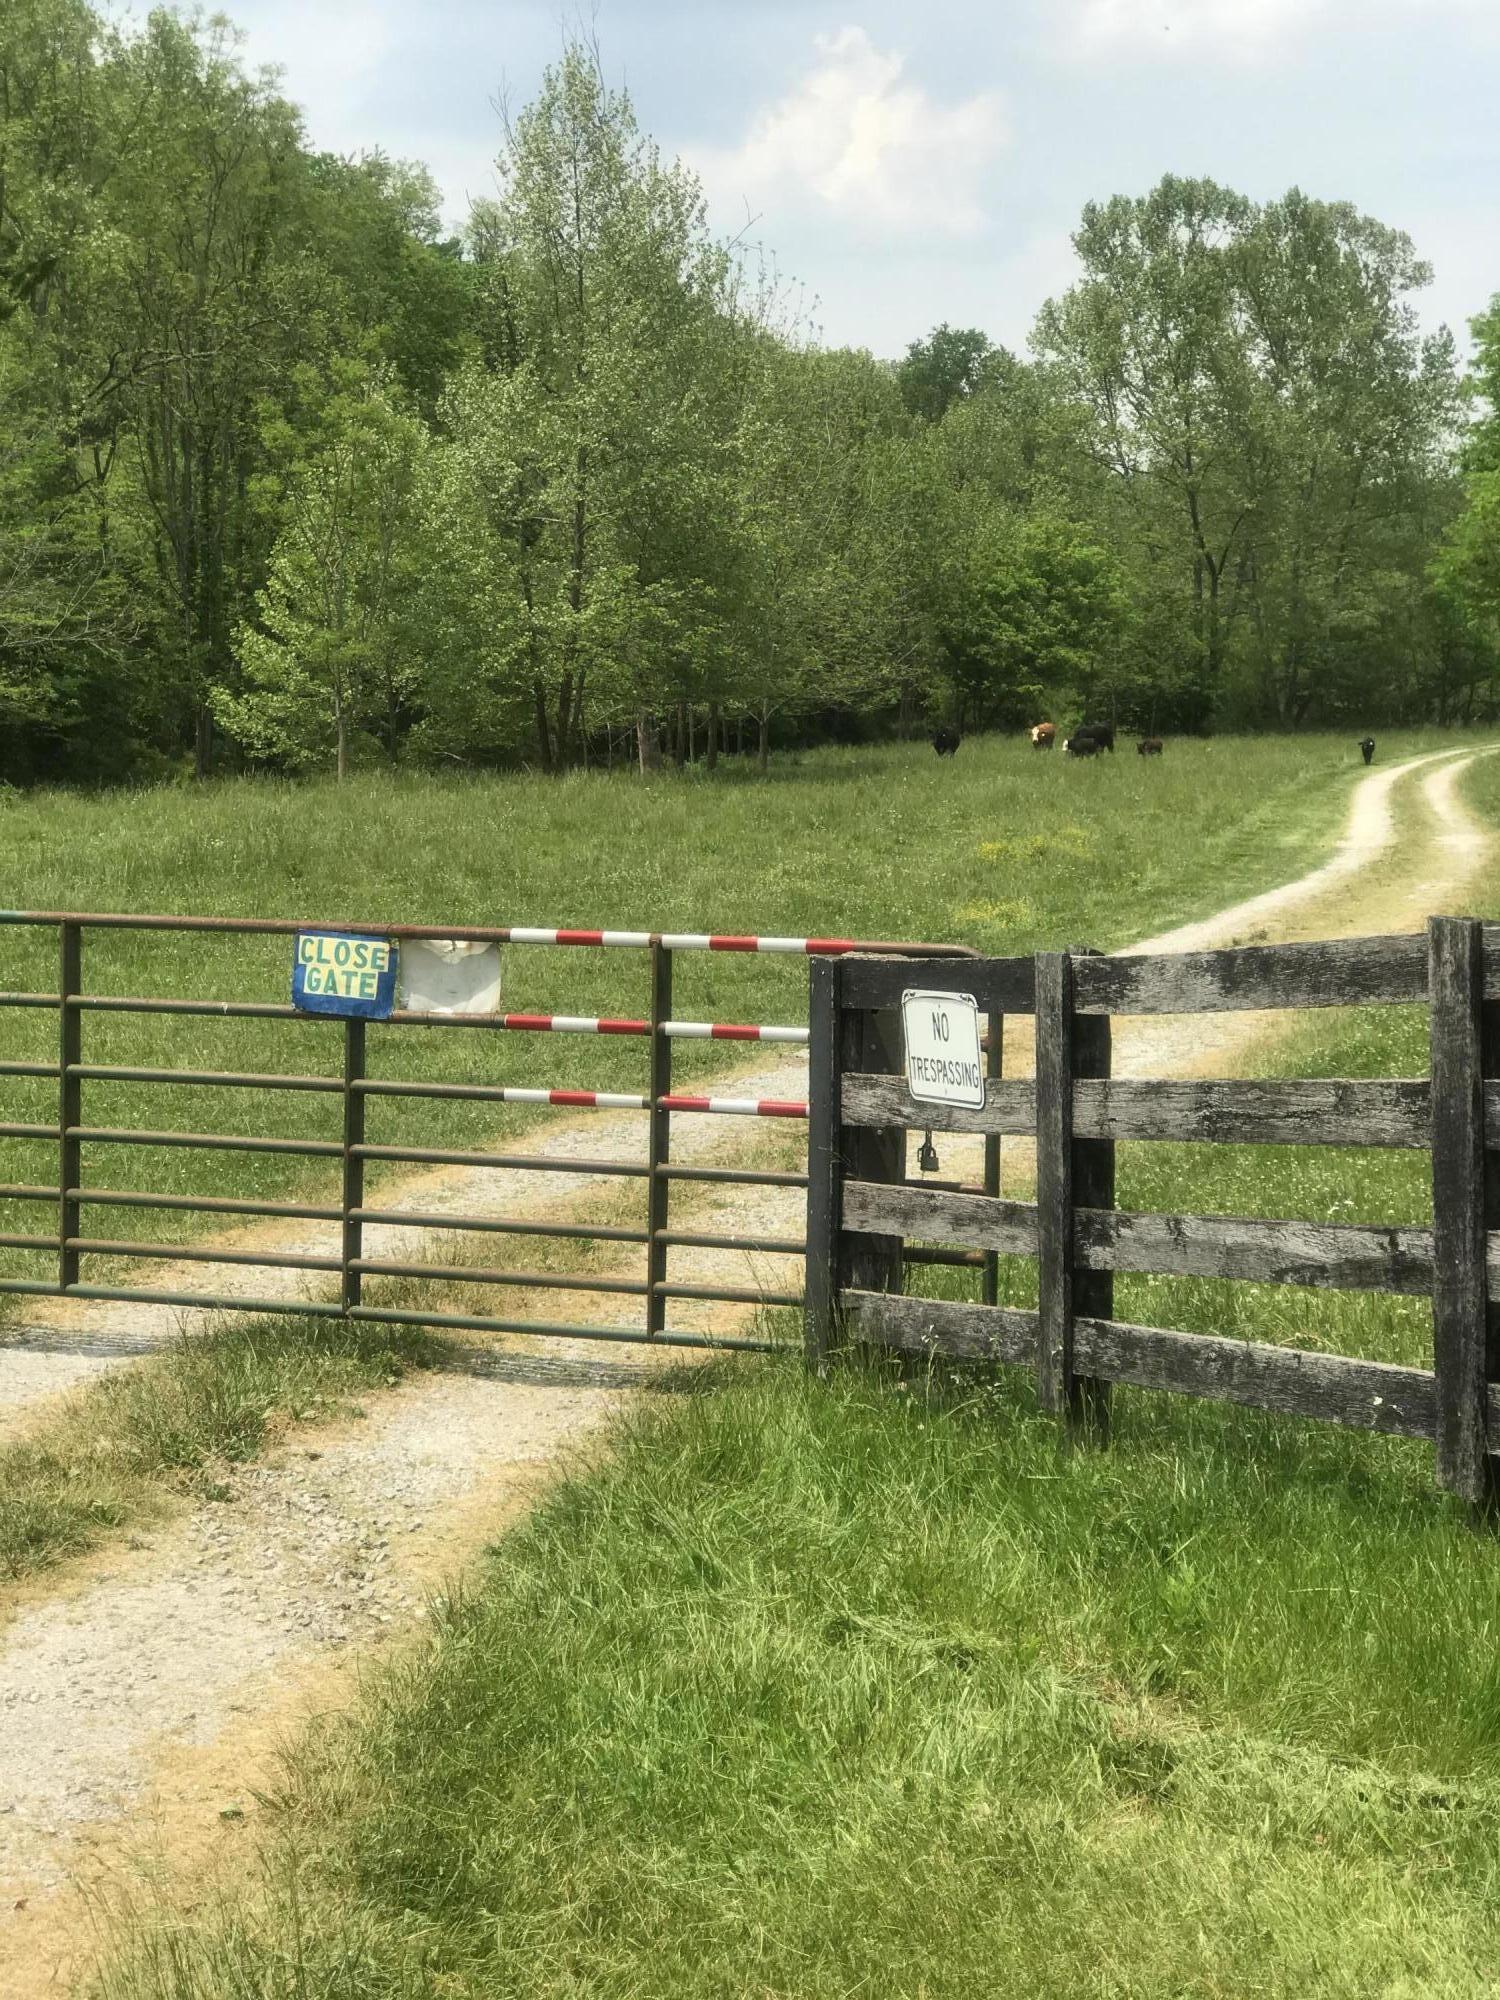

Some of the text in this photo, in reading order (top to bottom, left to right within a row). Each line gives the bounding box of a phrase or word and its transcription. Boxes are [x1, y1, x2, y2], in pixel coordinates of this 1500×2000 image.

[301, 937, 386, 970] CLOSE
[306, 967, 376, 998] GATE
[932, 1011, 950, 1042] NO
[911, 1055, 979, 1089] TRESPASSING
